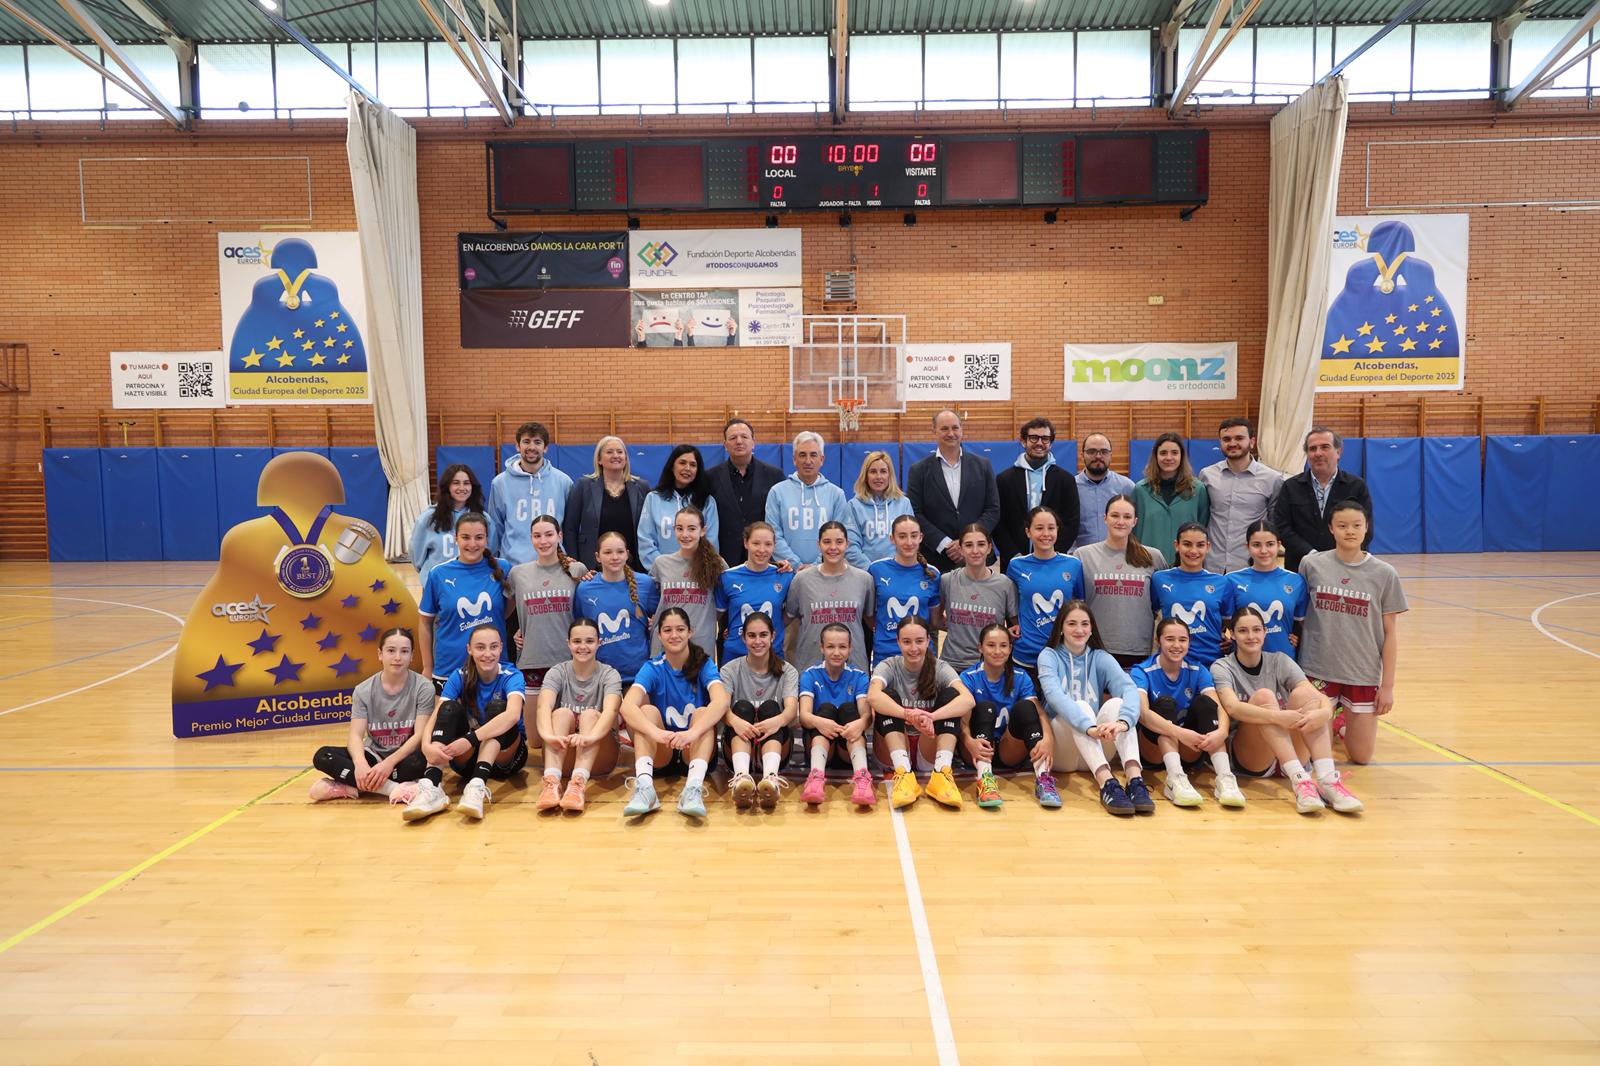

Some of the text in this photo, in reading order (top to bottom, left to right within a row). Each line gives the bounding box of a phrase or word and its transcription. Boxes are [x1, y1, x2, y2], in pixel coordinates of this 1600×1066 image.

[771, 145, 798, 164] 00
[910, 144, 936, 162] 00
[765, 169, 796, 178] LOCAL
[905, 168, 936, 176] VISITANTE
[774, 185, 783, 199] 0
[874, 184, 878, 197] 1
[918, 184, 928, 197] 0
[1333, 231, 1358, 242] ces
[224, 246, 261, 258] aces
[462, 242, 624, 251] EN ALCOBENDAS DAMOS LA CARA POR TI
[687, 249, 796, 259] Fundación Deporte Alcobendas
[528, 310, 584, 329] GEFF
[1072, 358, 1226, 382] moonz
[1354, 362, 1418, 370] Alcobendas,
[266, 376, 328, 384] Alcobendas,
[1320, 374, 1348, 382] Ciudad
[1350, 374, 1383, 382] Europea
[1400, 373, 1434, 382] Deporte
[1436, 372, 1455, 380] 2025
[233, 387, 260, 395] Ciudad
[311, 387, 343, 396] Deporte
[1179, 381, 1226, 390] ortodoncia
[516, 498, 556, 522] CBA
[788, 506, 828, 530] CBA
[866, 520, 893, 539] CB
[300, 557, 310, 570] 1
[663, 581, 700, 589] BALONCE
[1095, 586, 1144, 597] ALCOBENDAS
[1316, 585, 1371, 601] BALONCESTO
[211, 602, 258, 617] aces
[1315, 600, 1368, 617] ALCOBENDAS
[811, 614, 856, 624] ALCOBENDAS
[601, 632, 630, 645] studiantes
[256, 692, 352, 714] Alcobenda
[192, 710, 352, 732] Premio Mejor Ciudad Europe
[368, 720, 415, 730] ALONCEST
